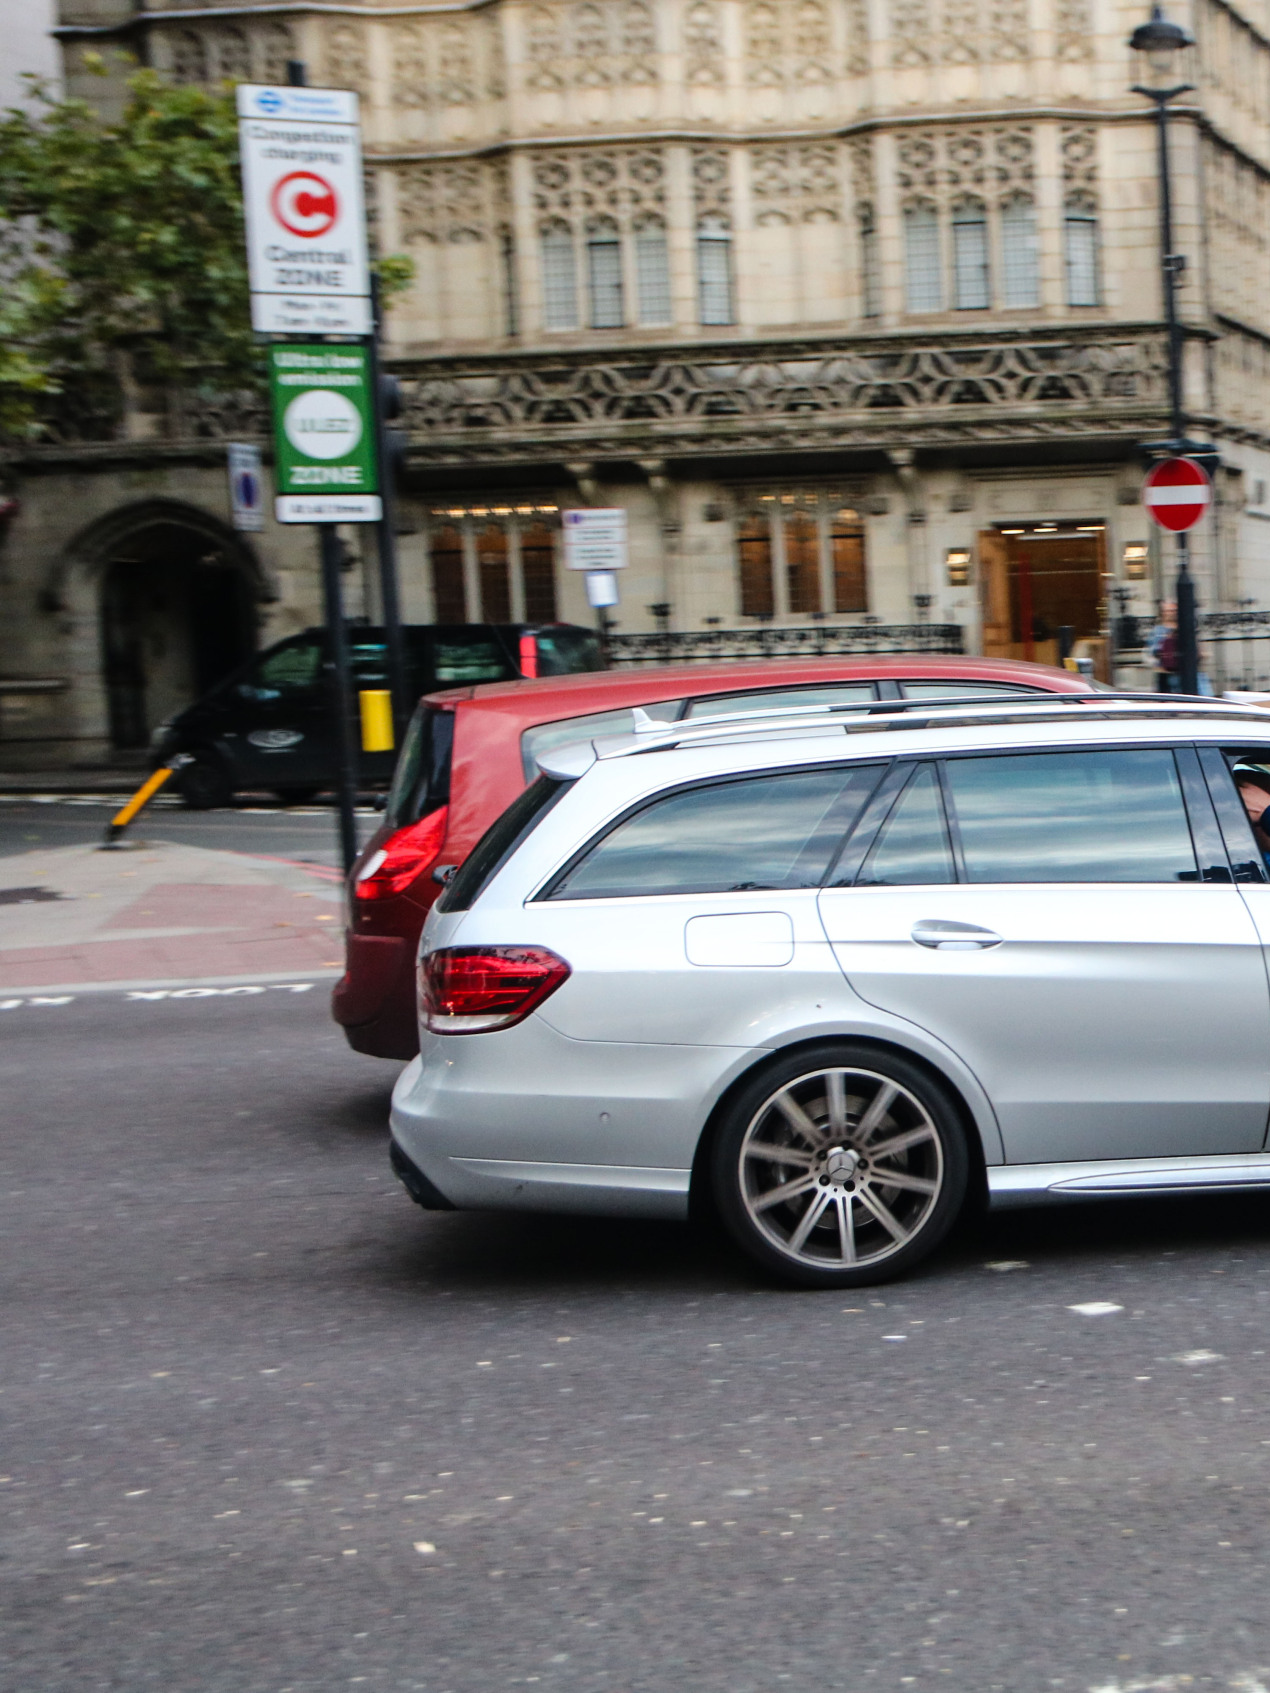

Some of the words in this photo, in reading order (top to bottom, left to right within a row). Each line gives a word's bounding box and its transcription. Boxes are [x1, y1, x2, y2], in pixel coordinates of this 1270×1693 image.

[249, 127, 351, 144] Congestion
[262, 147, 342, 163] charging
[264, 245, 351, 262] Central
[273, 269, 343, 286] ZONE
[289, 466, 363, 484] ZONE
[125, 983, 316, 1001] LOOK
